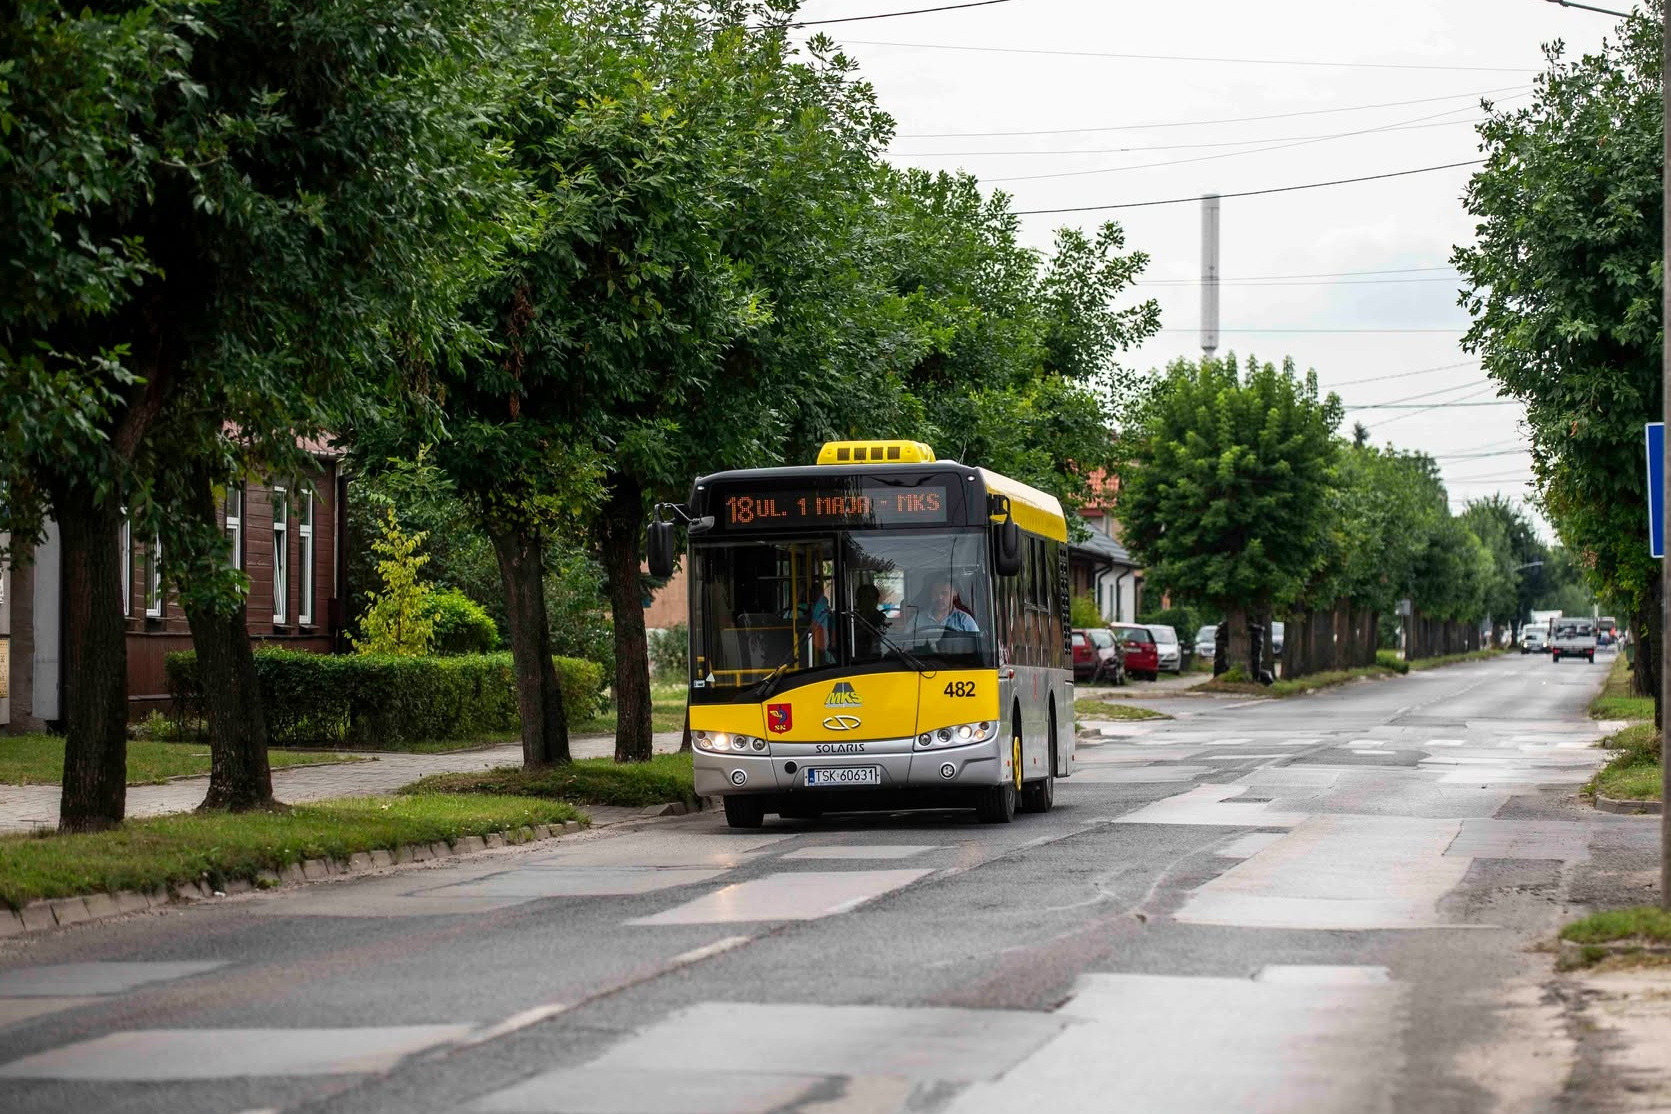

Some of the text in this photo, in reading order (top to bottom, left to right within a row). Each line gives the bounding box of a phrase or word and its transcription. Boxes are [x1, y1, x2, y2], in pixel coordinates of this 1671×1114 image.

[726, 496, 754, 523] 18
[756, 499, 787, 517] UL.
[797, 498, 806, 516] 1
[816, 496, 870, 515] MAJA
[897, 493, 940, 511] MKS
[943, 681, 976, 698] 482
[824, 691, 863, 706] MKS
[815, 743, 865, 754] SOLARIS
[815, 770, 836, 782] TSK
[839, 769, 874, 781] 60631
